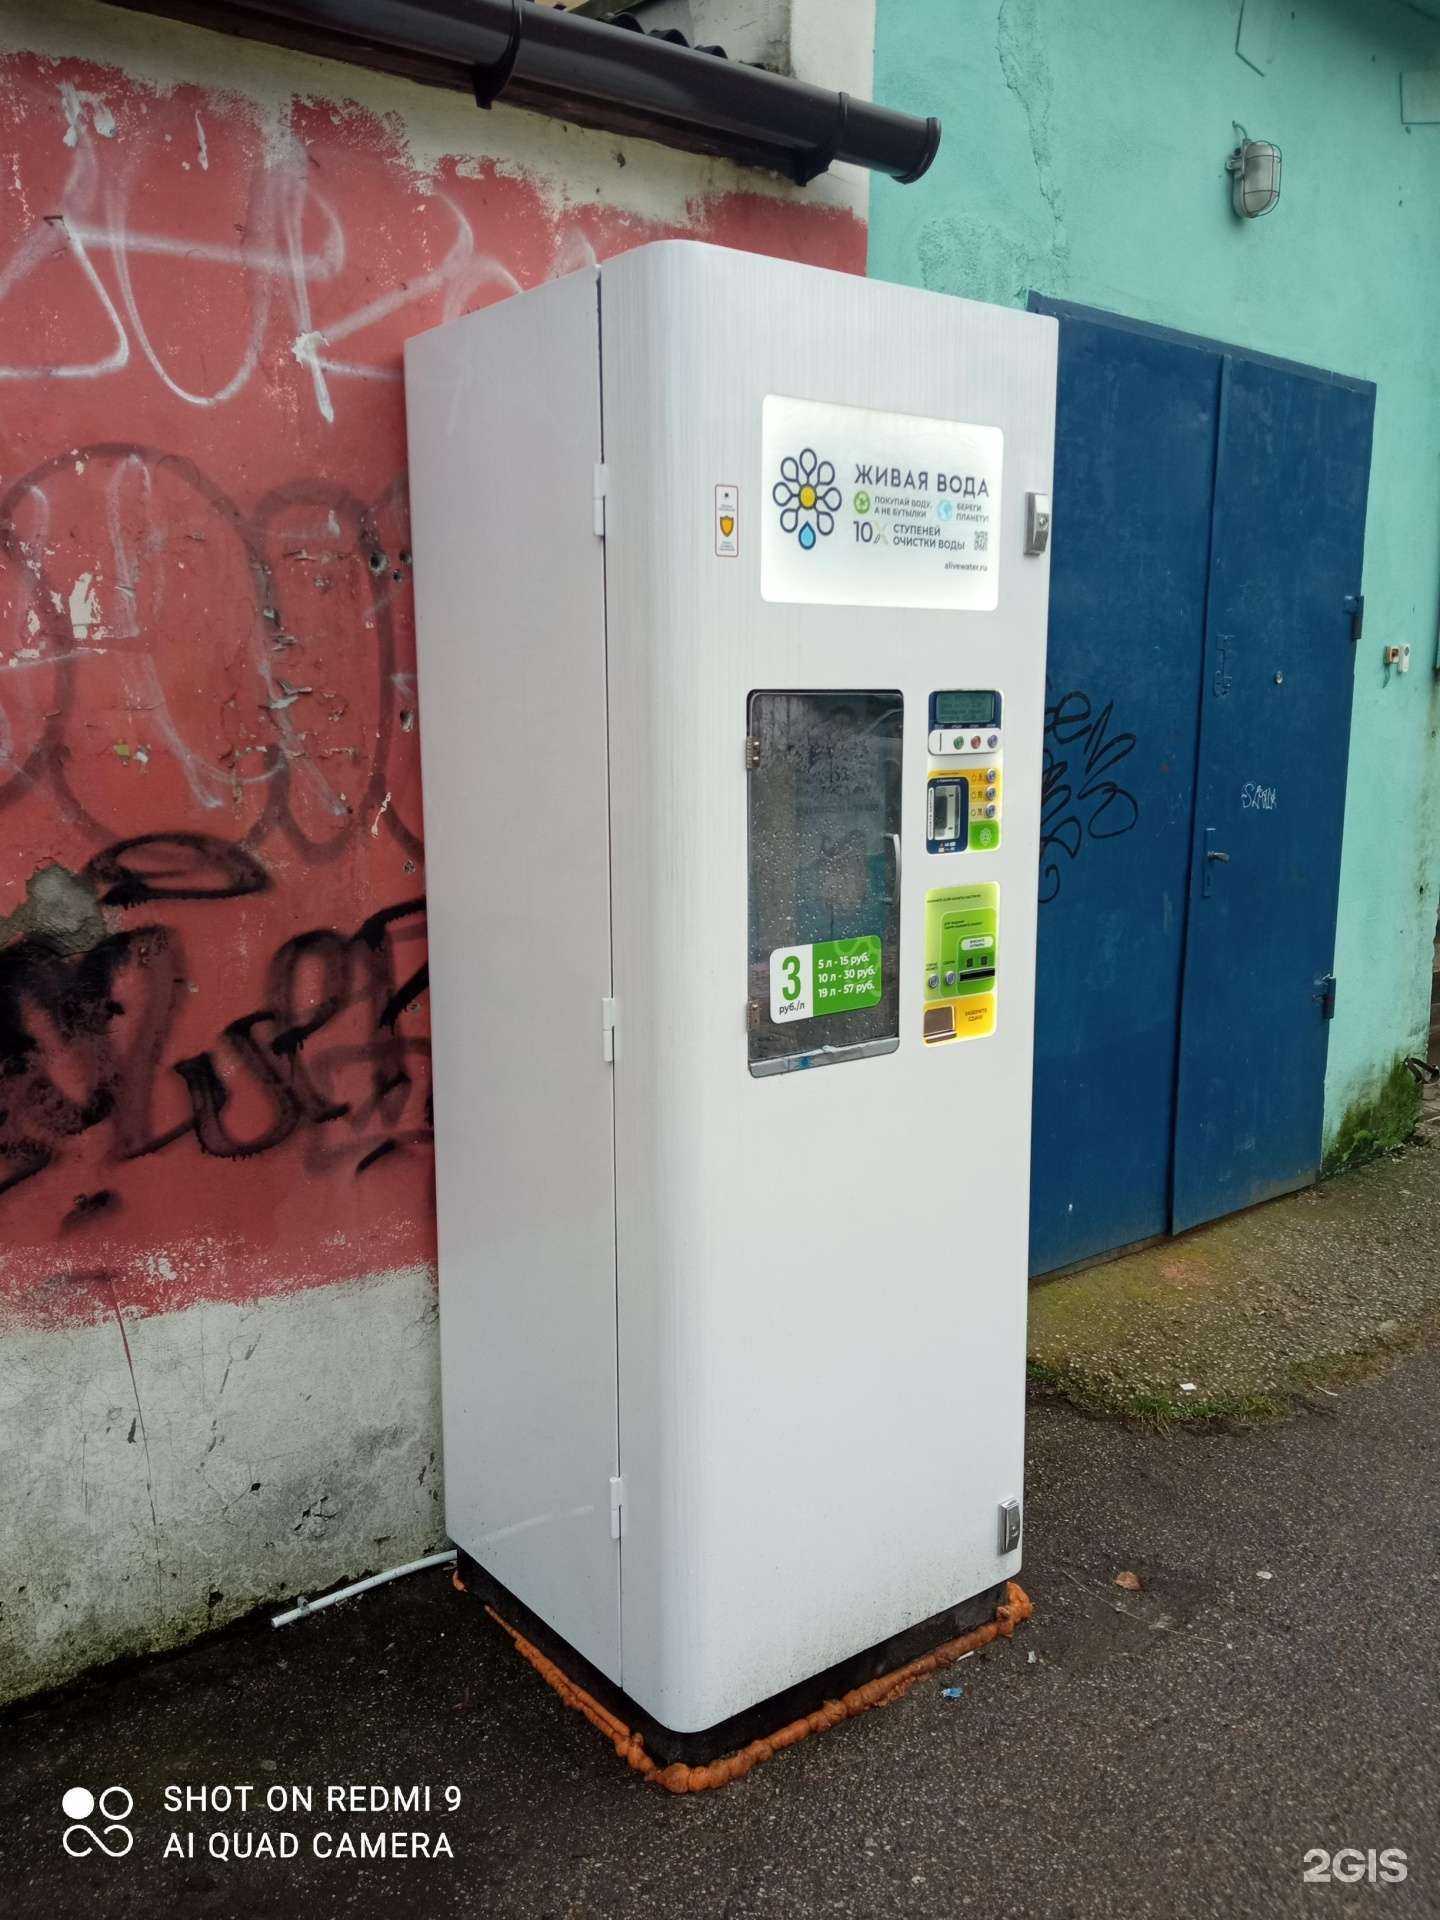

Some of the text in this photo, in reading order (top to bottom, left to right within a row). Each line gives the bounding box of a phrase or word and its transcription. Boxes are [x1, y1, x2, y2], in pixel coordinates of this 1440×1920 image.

[854, 464, 989, 498] ЖИВАЯ ВОДА
[874, 496, 910, 506] ПОКУПАЙ
[956, 503, 982, 512] БЕРЕГИ
[892, 509, 927, 518] БУТЫЛКИ
[893, 524, 941, 536] СТУПЕНЕЙ
[893, 536, 965, 551] ОЧИСТКИ ВОДЫ
[944, 562, 988, 572] alivewater.ru
[818, 960, 824, 968] 5
[840, 956, 848, 966] 15
[850, 952, 870, 966] руб.
[782, 955, 801, 1000] 3
[818, 974, 828, 983] 10
[830, 974, 836, 982] л
[844, 969, 854, 979] 30
[856, 965, 876, 979] руб.
[818, 988, 828, 998] 19
[844, 984, 854, 994] 57
[856, 980, 875, 993] руб.
[779, 1000, 805, 1015] руб./л
